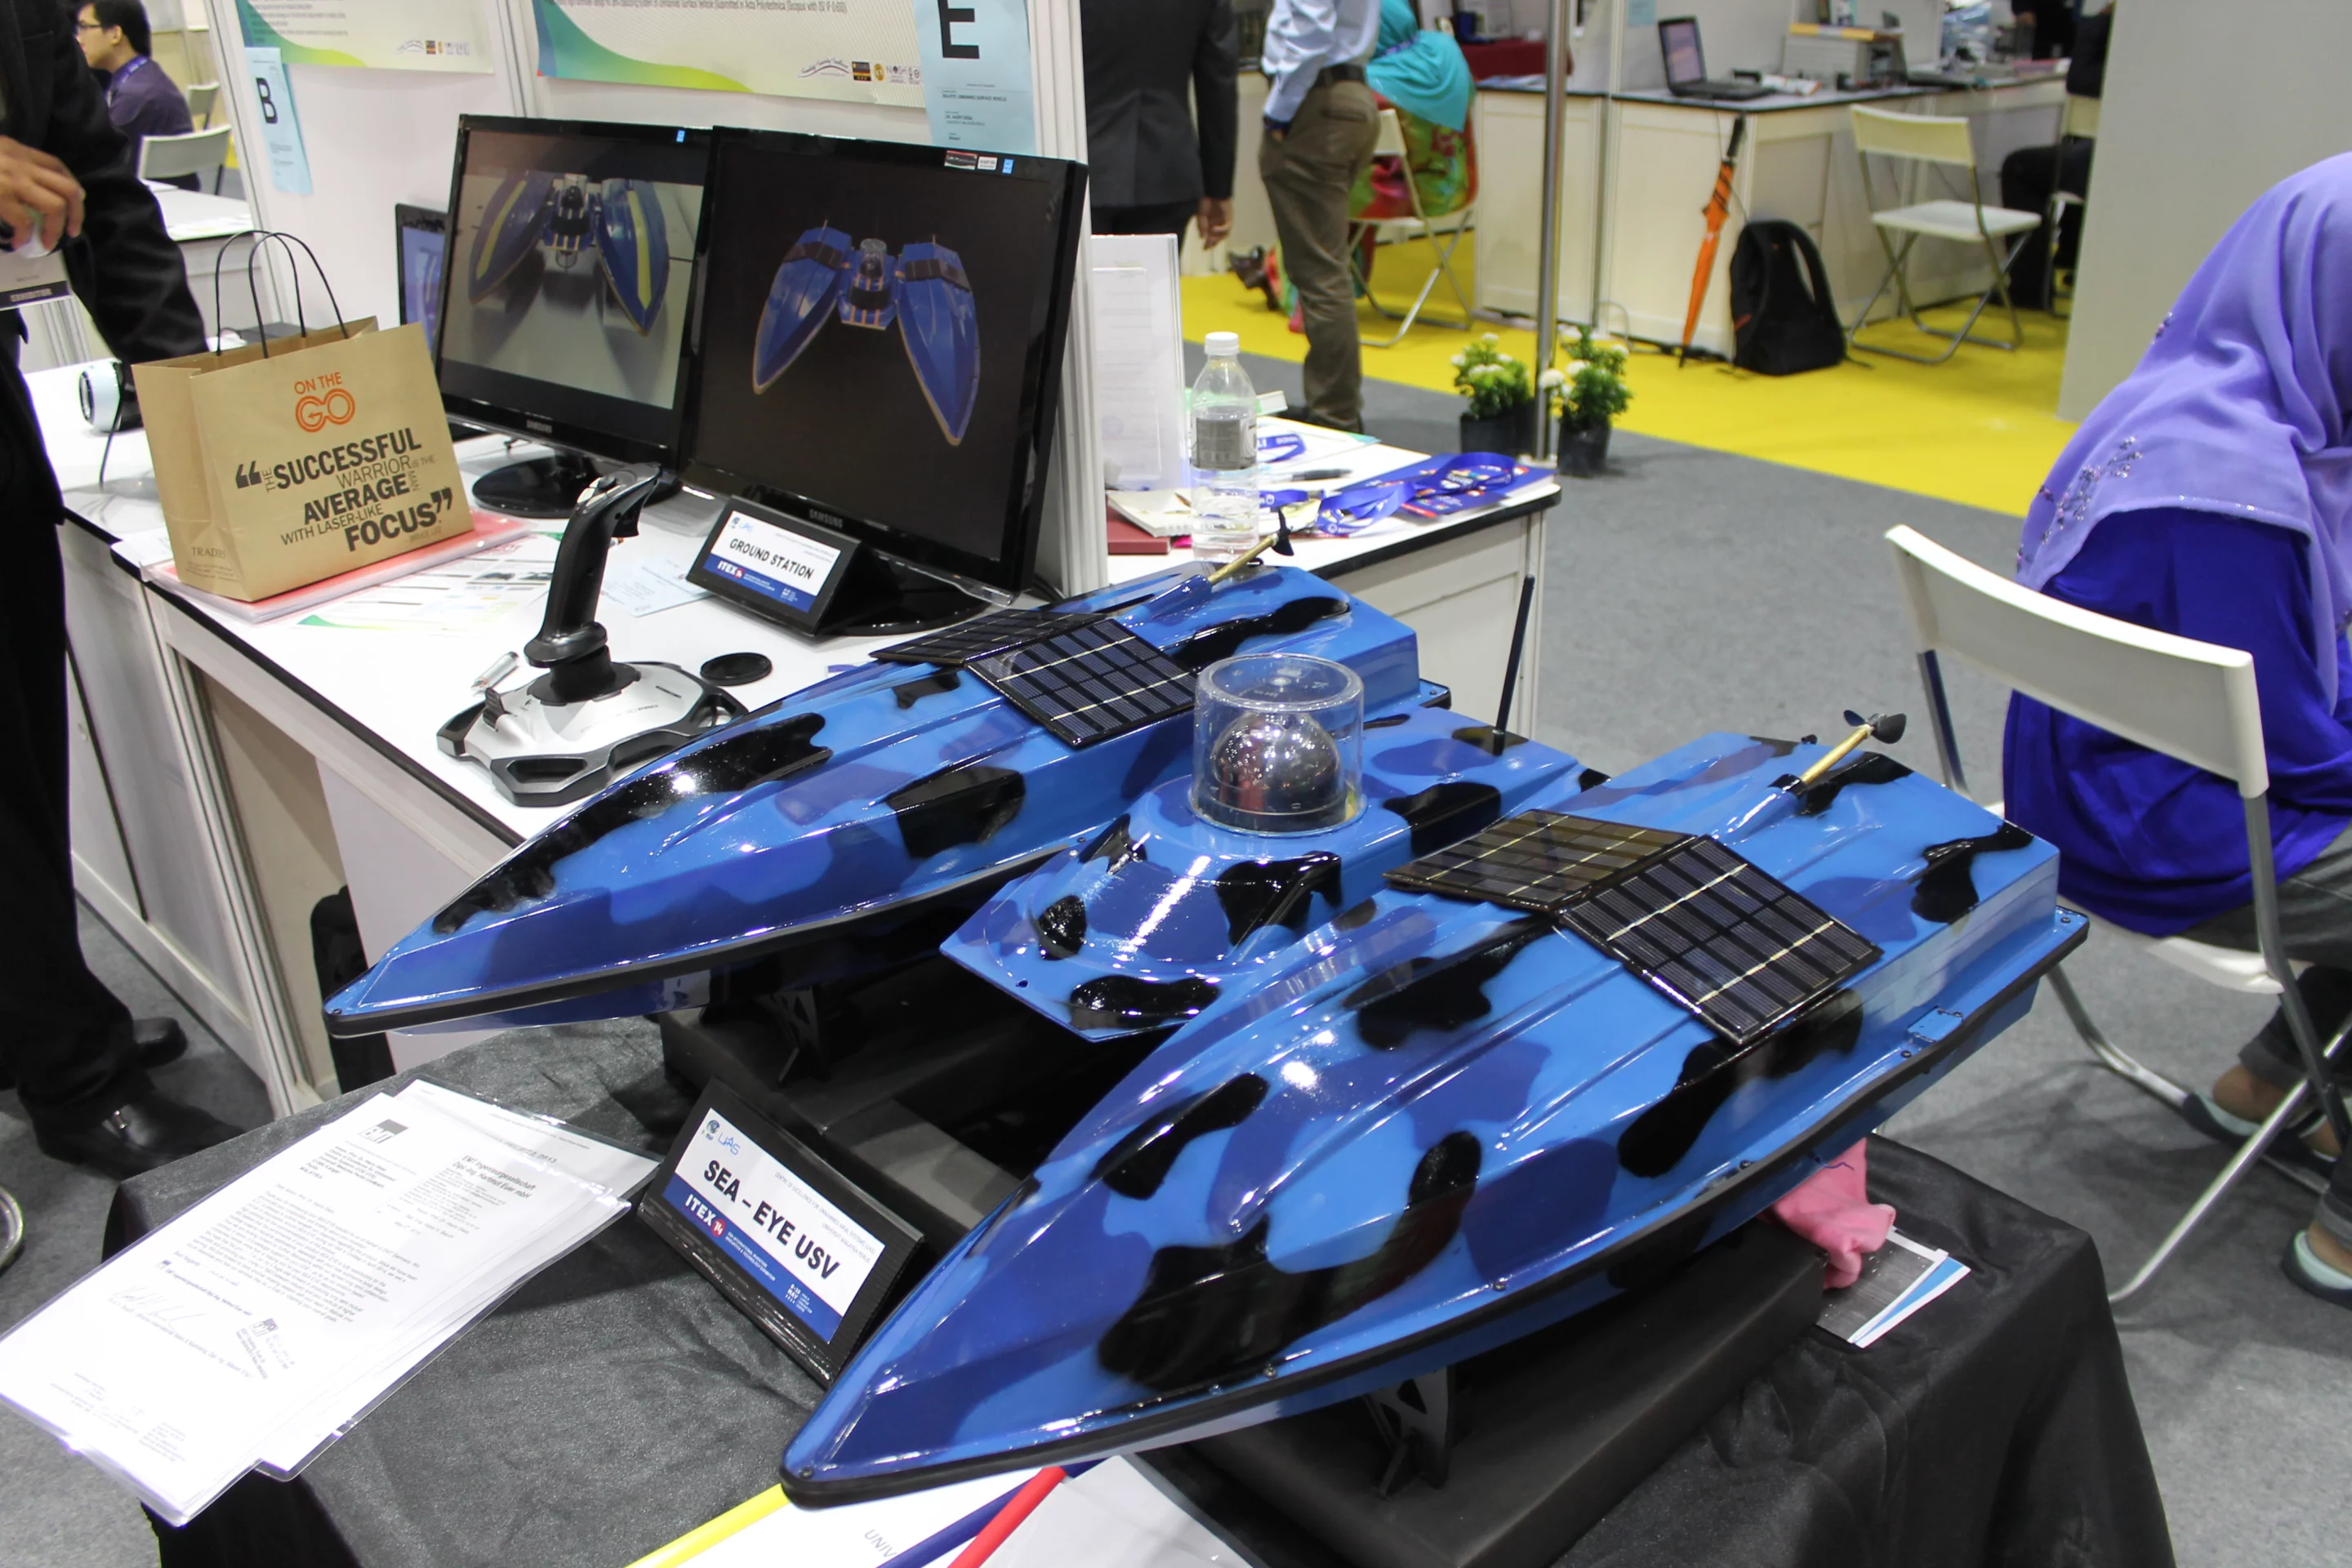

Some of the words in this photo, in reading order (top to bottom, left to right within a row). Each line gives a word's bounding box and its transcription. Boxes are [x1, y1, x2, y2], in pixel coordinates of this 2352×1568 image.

[256, 77, 278, 124] B
[294, 379, 317, 395] ON
[318, 372, 343, 389] THE
[295, 388, 356, 433] GO
[273, 427, 422, 490] SUCCESSFUL
[336, 455, 412, 489] WARRIOR
[262, 467, 276, 493] THE
[304, 473, 410, 526] AVERAGE
[809, 508, 843, 529] SAMSUNG
[281, 527, 315, 546] WITH
[317, 502, 385, 535] LASER-LIKE
[717, 560, 737, 575] ITEX
[729, 537, 770, 561] GROUND
[769, 554, 814, 579] STATION
[358, 1125, 395, 1144] EMT
[717, 1131, 741, 1156] UAS
[684, 1193, 716, 1226] ITEX
[713, 1220, 723, 1235] 14
[703, 1160, 740, 1202] SEA
[752, 1200, 795, 1245] EYE
[795, 1233, 840, 1279] USV
[865, 1529, 898, 1557] UNIV
